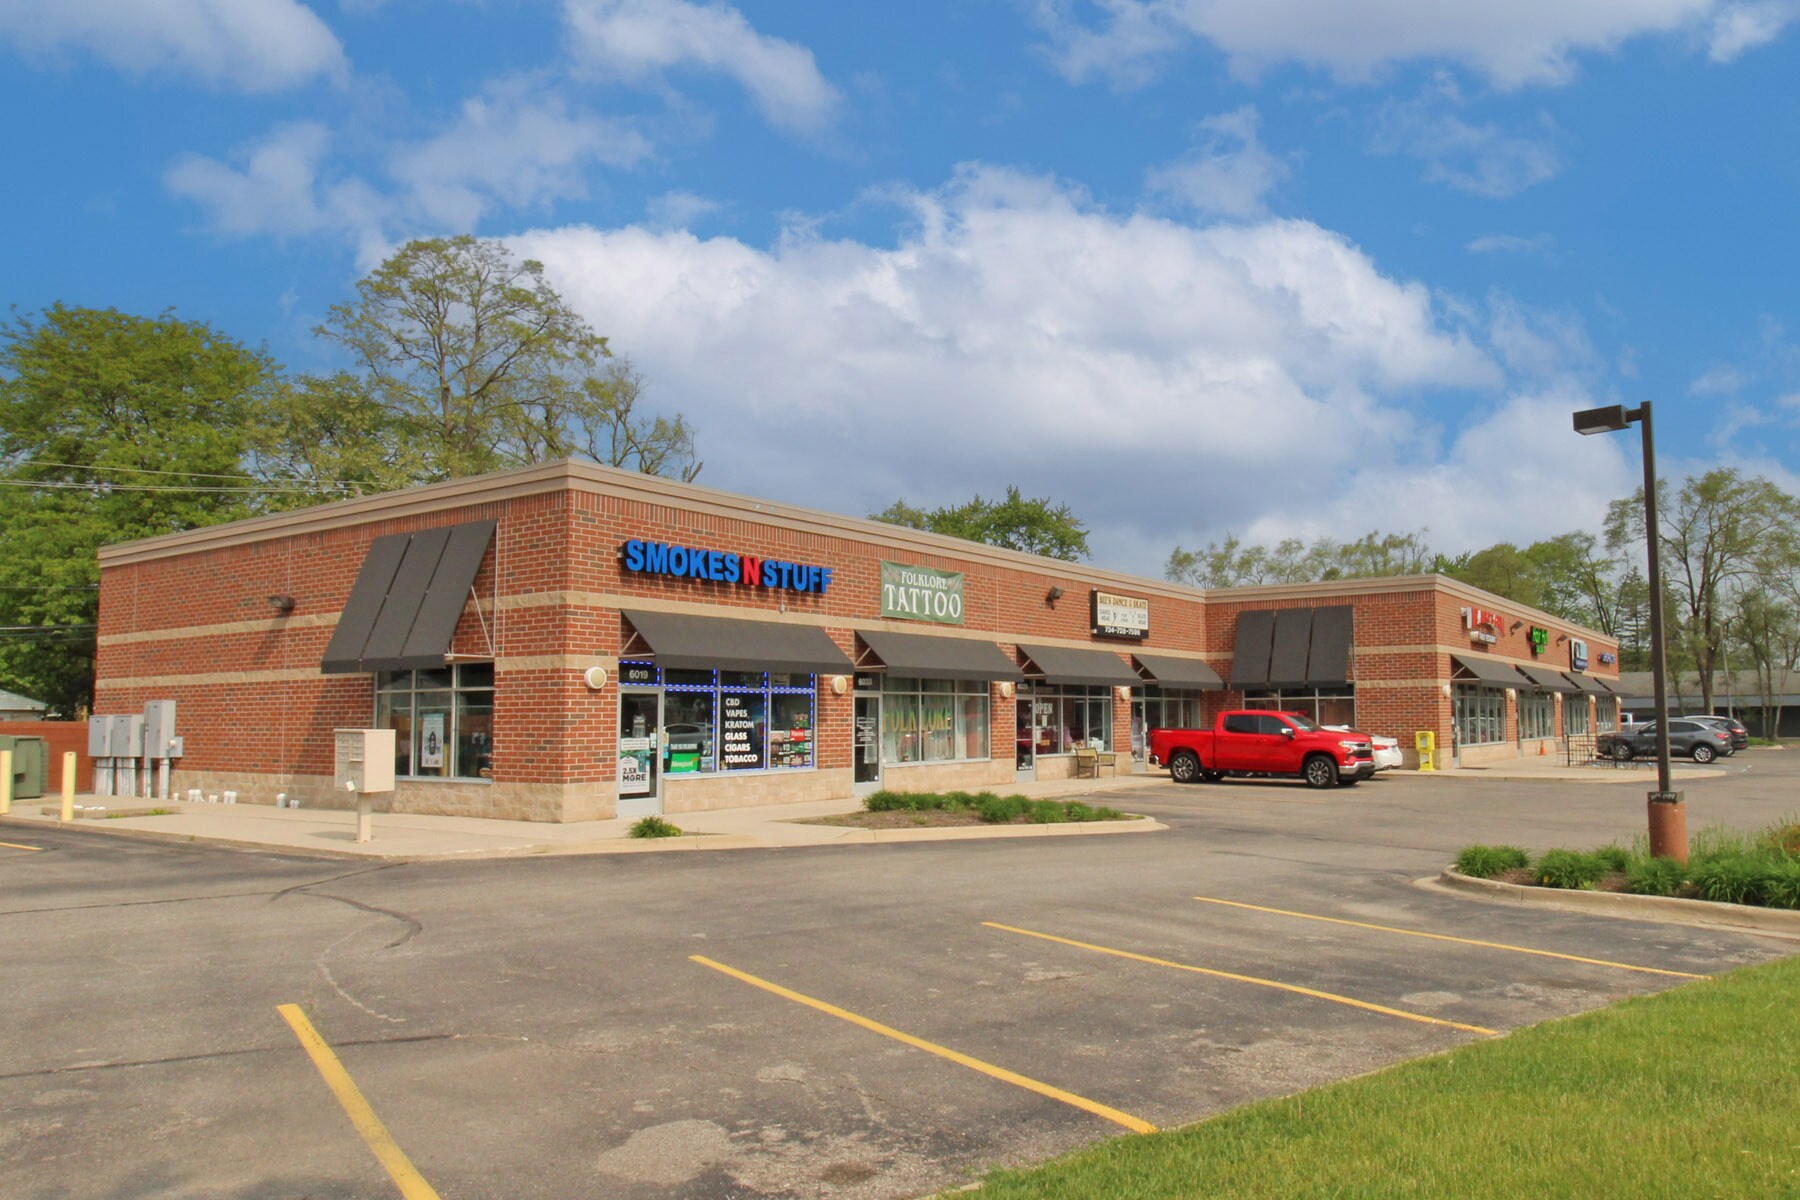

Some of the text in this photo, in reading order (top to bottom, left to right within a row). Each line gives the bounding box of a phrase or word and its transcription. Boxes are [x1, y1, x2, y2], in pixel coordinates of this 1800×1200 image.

[626, 539, 833, 593] SMOKES N STUFF
[901, 571, 948, 590] FOLKLORE
[884, 583, 961, 618] TATTOO
[629, 669, 649, 679] 6019
[725, 698, 740, 706] CBD
[1035, 703, 1053, 714] OPEN
[726, 709, 748, 718] VAPES
[725, 721, 754, 729] KRATOM
[725, 732, 748, 741] GLASS
[725, 743, 751, 752] CIGARS
[725, 754, 758, 763] TOBACCO
[622, 774, 647, 782] MORE
